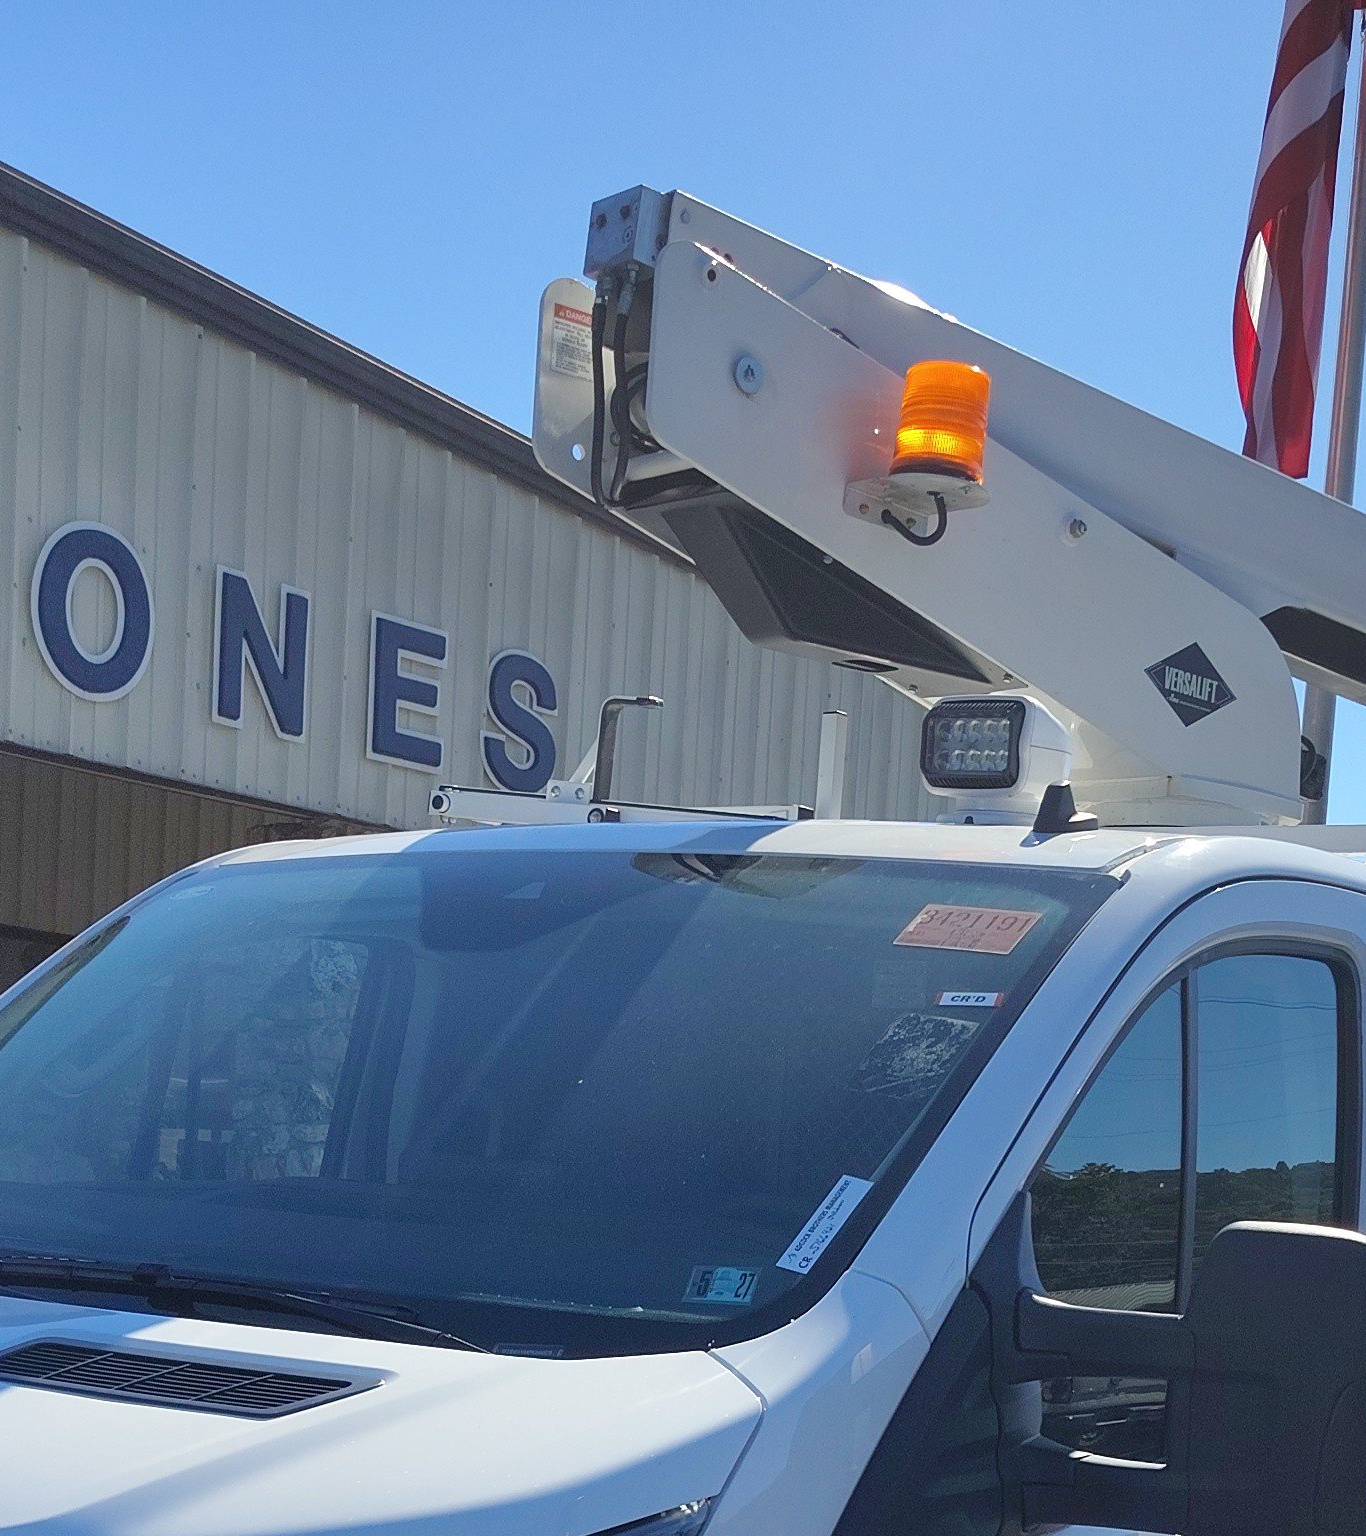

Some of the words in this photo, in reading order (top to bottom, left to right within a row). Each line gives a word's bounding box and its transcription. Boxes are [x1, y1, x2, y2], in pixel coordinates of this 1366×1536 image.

[1164, 665, 1219, 704] VERSALIFT
[950, 994, 987, 1004] CR'D
[734, 1272, 757, 1299] 27
